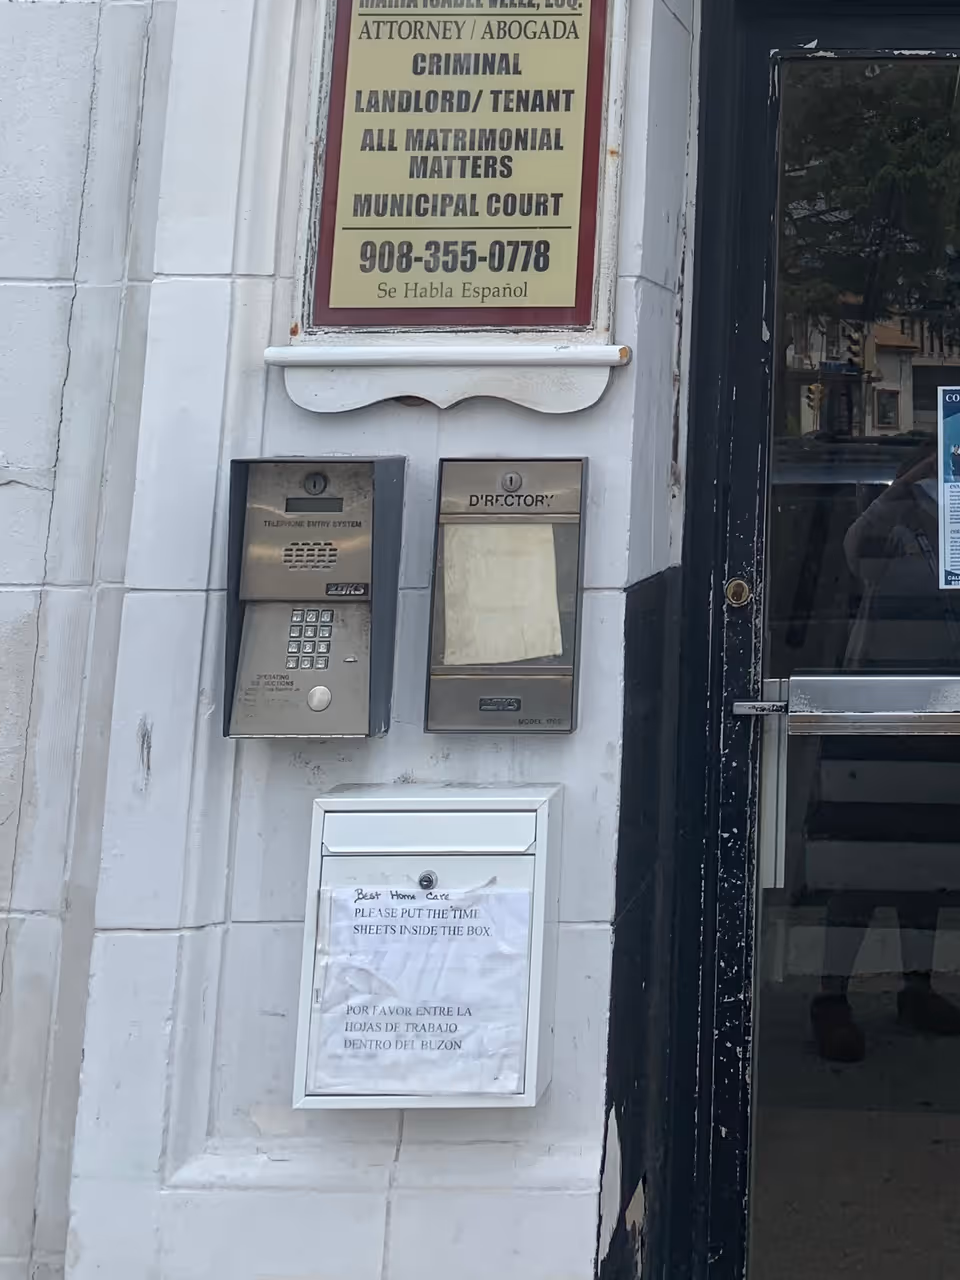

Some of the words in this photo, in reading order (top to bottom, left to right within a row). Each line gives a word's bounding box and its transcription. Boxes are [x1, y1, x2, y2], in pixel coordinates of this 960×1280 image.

[358, 20, 465, 40] ATTORNEY
[470, 20, 476, 40] /
[481, 20, 579, 39] ABOGADA
[413, 53, 521, 75] CRIMINAL
[355, 90, 483, 113] LANDLORD/
[490, 90, 574, 112] TENANT
[360, 129, 397, 151] ALL
[405, 128, 563, 151] MATRIMONIAL
[409, 155, 513, 178] MATTERS
[353, 194, 479, 217] MUNICIPAL
[487, 193, 563, 216] COURT
[360, 240, 550, 273] 908-355-0778
[378, 282, 396, 298] Se
[404, 282, 453, 298] Habla
[462, 282, 527, 303] Español
[332, 520, 362, 528] SYSTEM
[354, 888, 382, 903] Best
[390, 890, 416, 902] Home
[425, 891, 450, 902] Care
[354, 908, 398, 919] PLEASE
[400, 908, 423, 919] PUT
[425, 908, 449, 919] THE
[450, 908, 480, 920] TIME
[352, 924, 397, 935] SHEETS
[399, 925, 438, 936] INSIDE
[440, 925, 464, 936] THE
[466, 925, 493, 937] BOX.
[346, 1004, 369, 1015] POR
[372, 1004, 412, 1016] FAVOR
[415, 1006, 454, 1016] ENTRE
[456, 1006, 472, 1017] LA
[344, 1021, 382, 1033] HOJAS
[384, 1022, 400, 1033] DE
[404, 1022, 458, 1033] TRABAJO
[343, 1039, 392, 1050] DENTRO
[395, 1039, 418, 1050] DEL
[421, 1040, 463, 1051] BUZON
